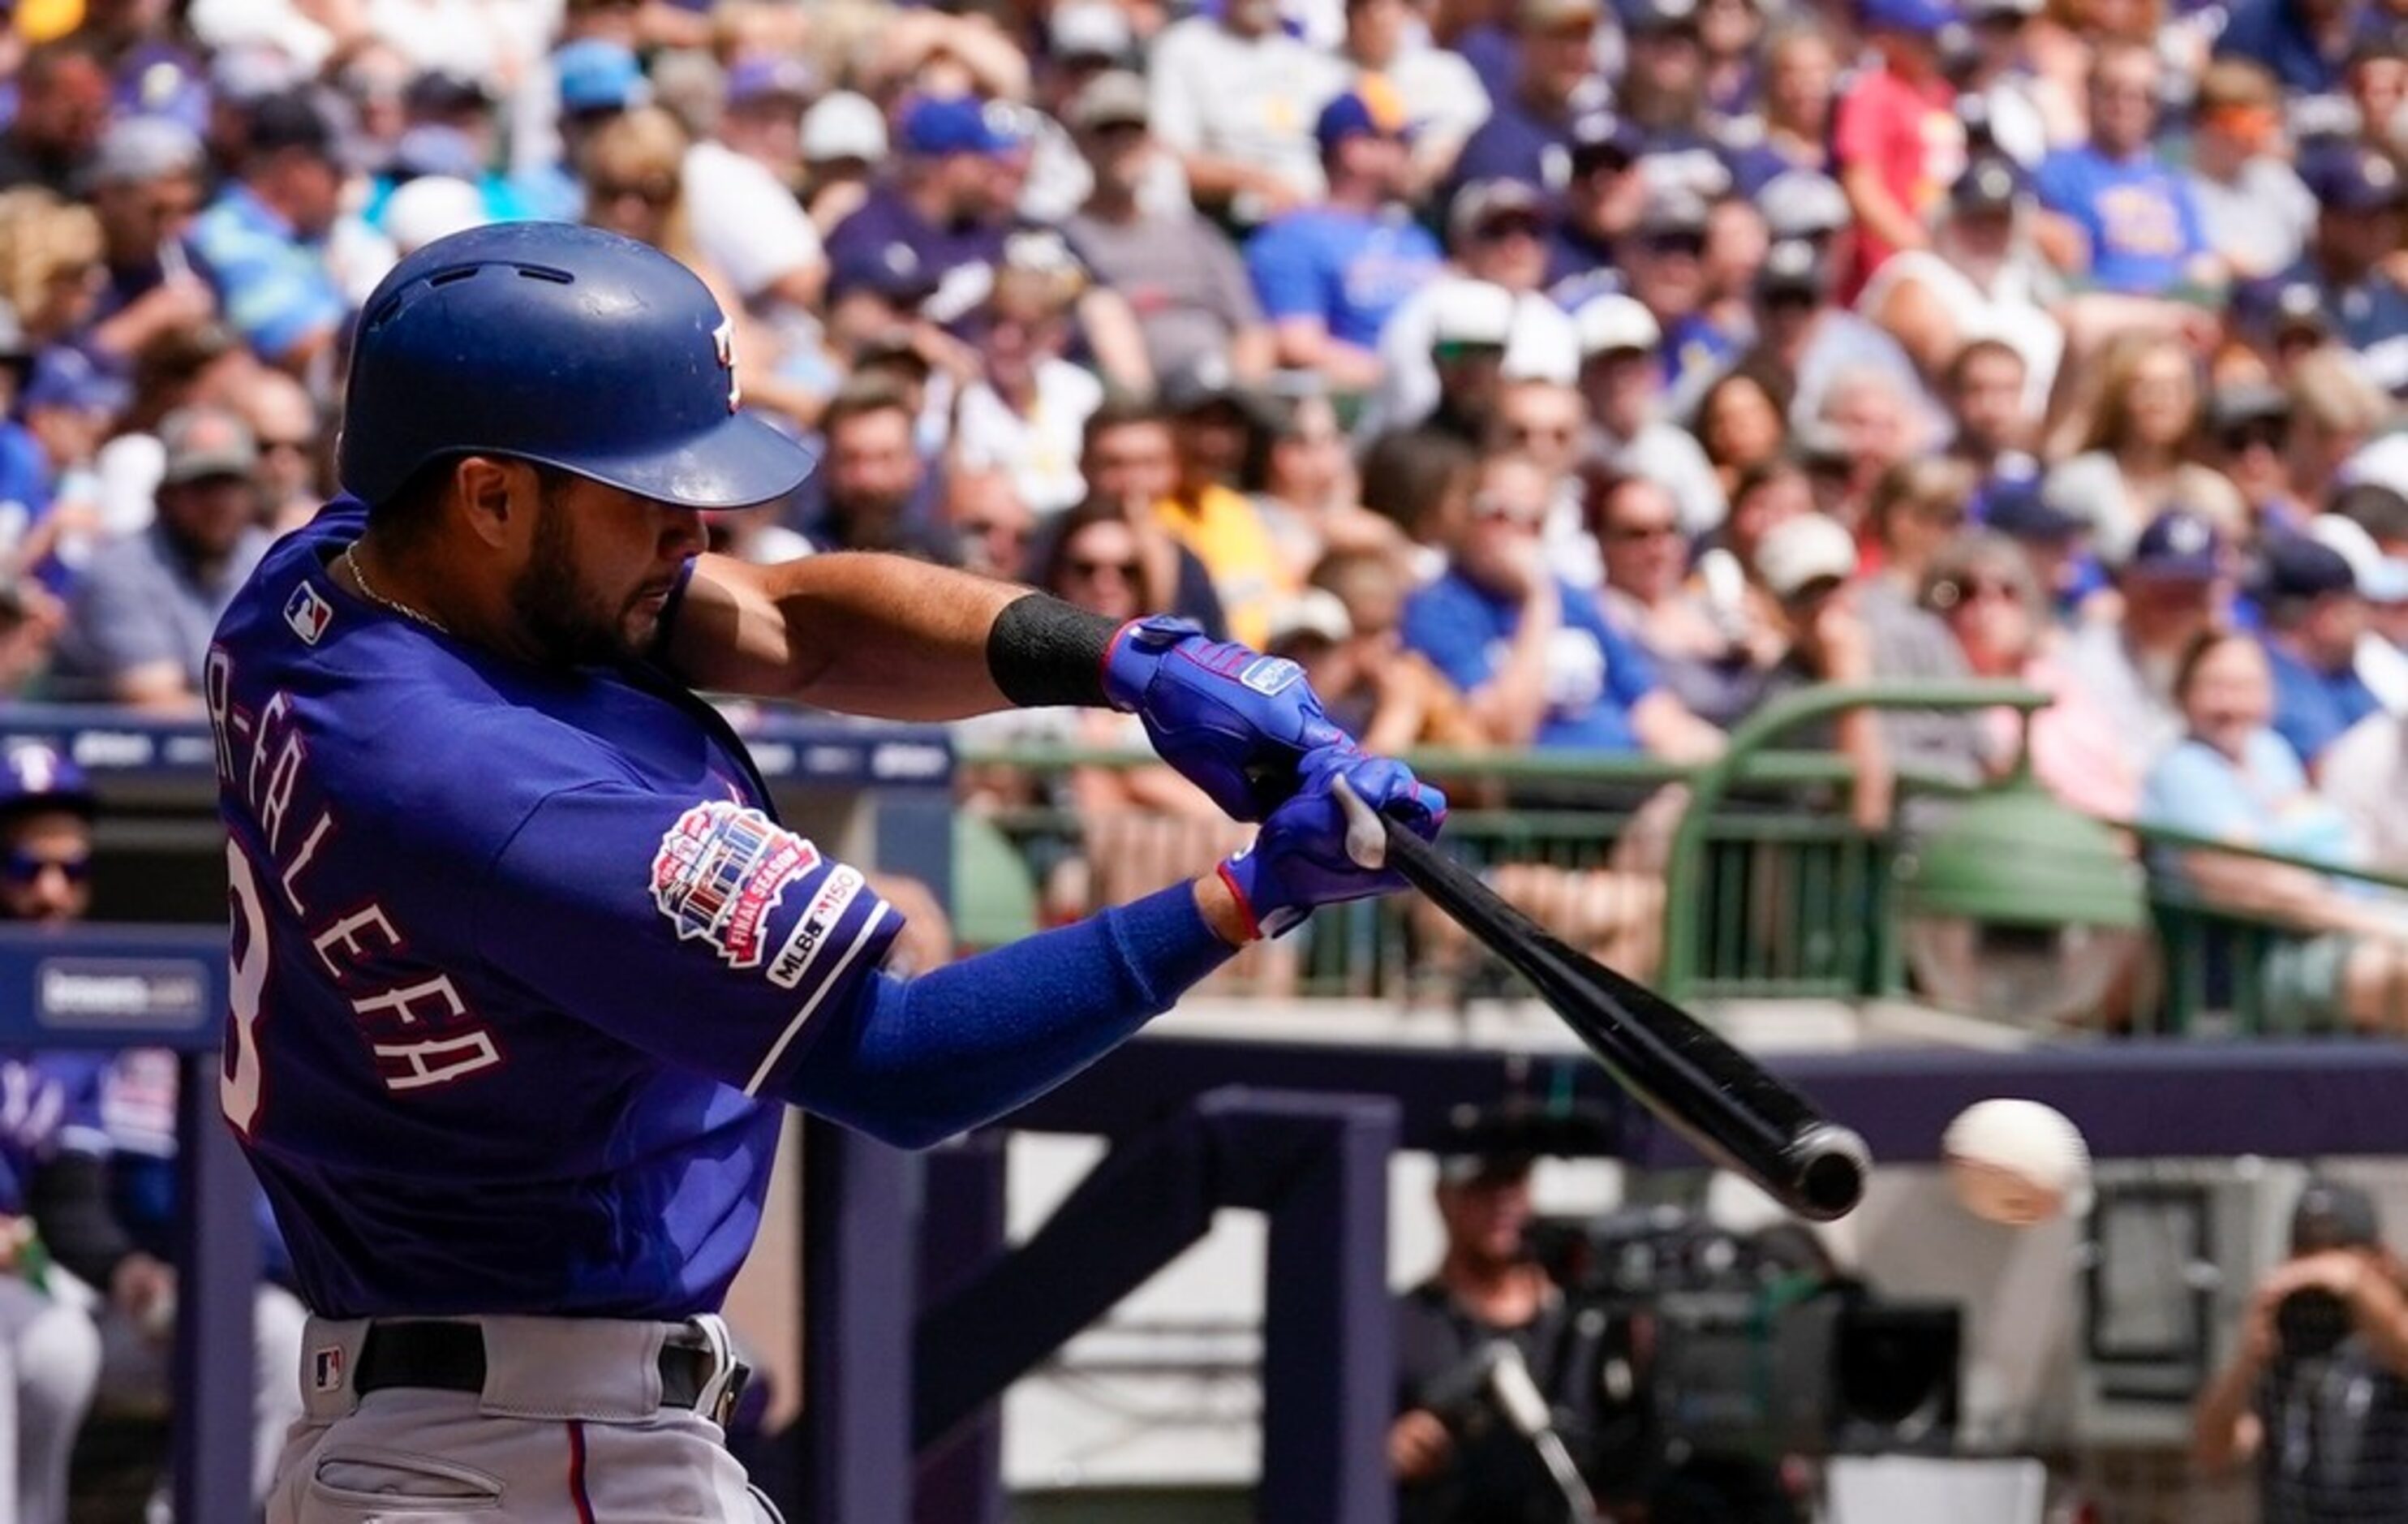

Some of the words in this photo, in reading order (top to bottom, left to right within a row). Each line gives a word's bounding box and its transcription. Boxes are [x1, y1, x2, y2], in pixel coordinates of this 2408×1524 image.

[730, 898, 763, 947] FINAL
[749, 845, 801, 900] SEASON
[774, 933, 816, 982] MLB
